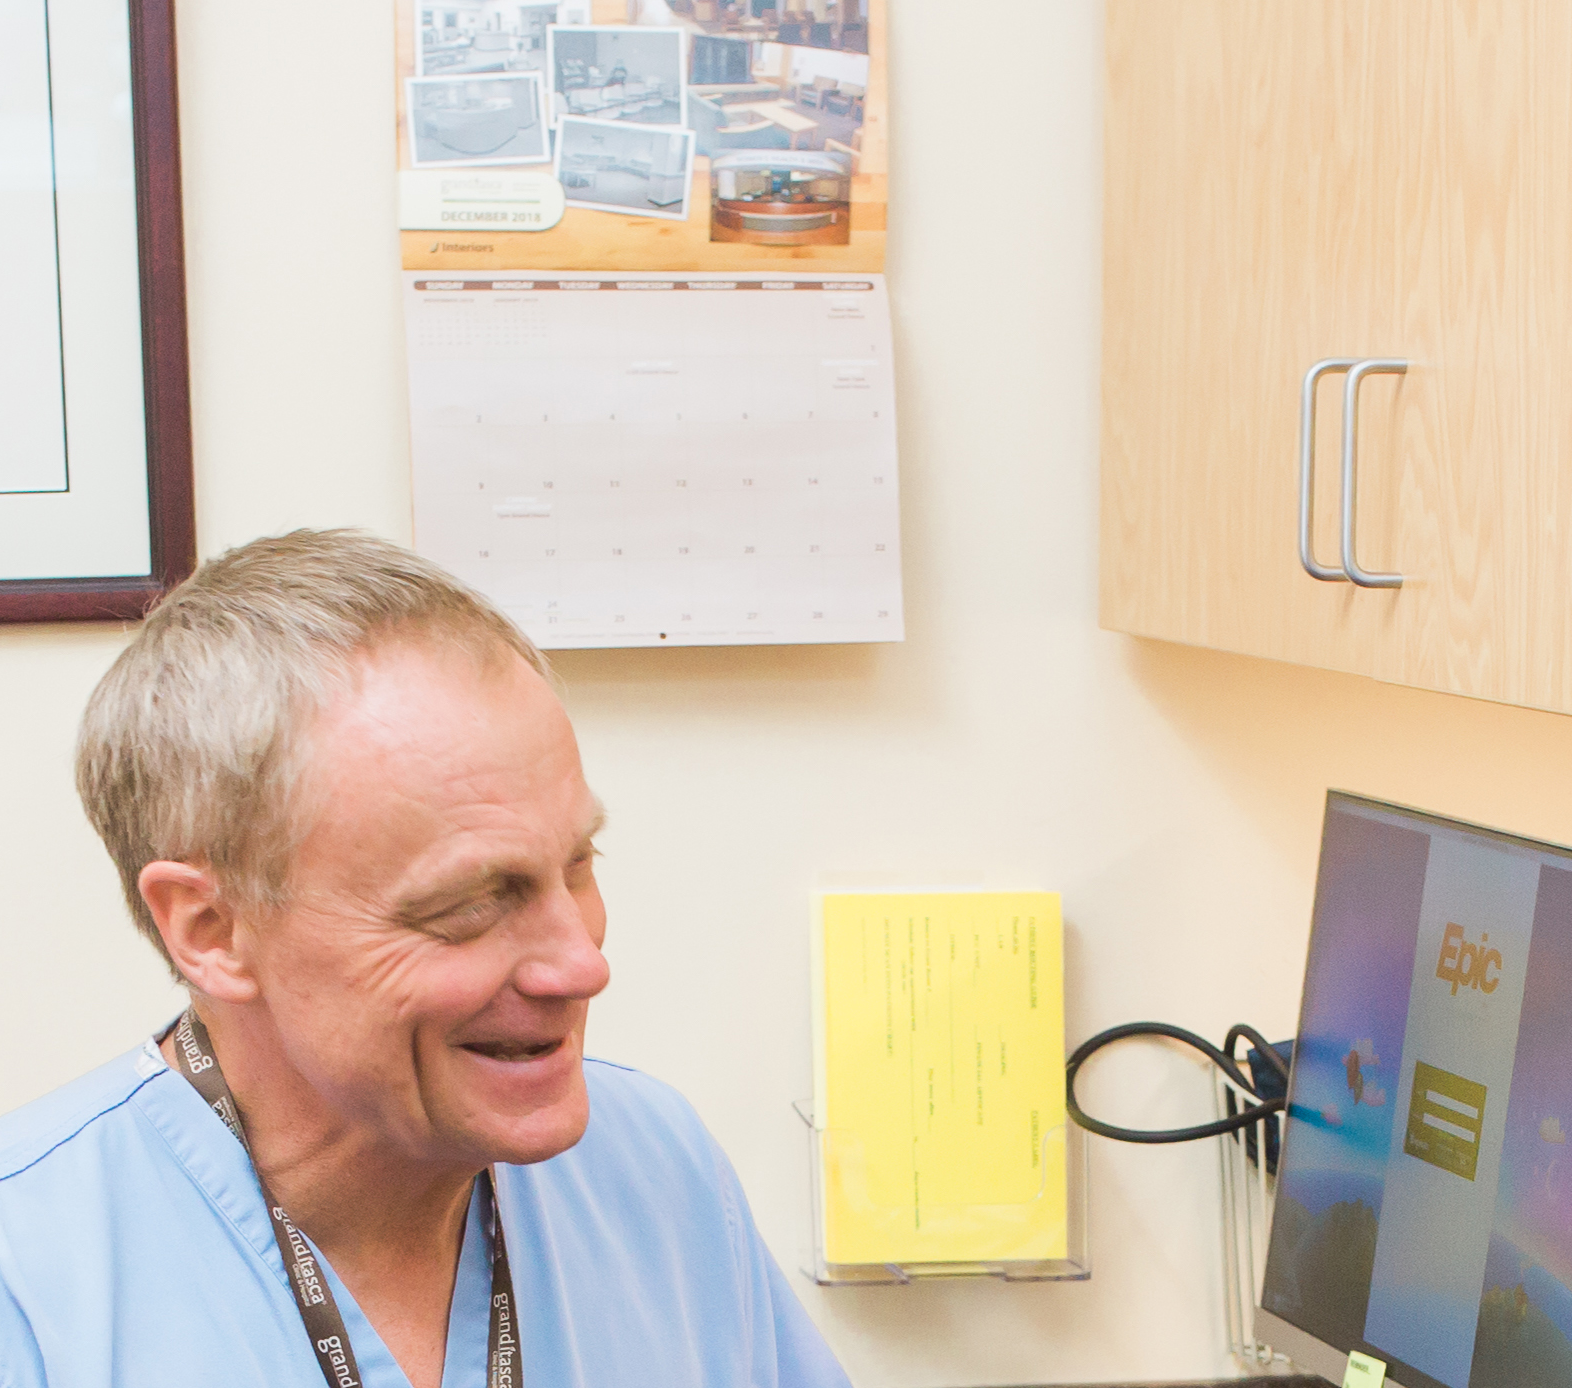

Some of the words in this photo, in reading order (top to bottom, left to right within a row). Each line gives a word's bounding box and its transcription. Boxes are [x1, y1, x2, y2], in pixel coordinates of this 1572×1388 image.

[441, 211, 508, 222] DECEMBER
[442, 242, 495, 253] Interiors
[1435, 922, 1503, 996] Epic
